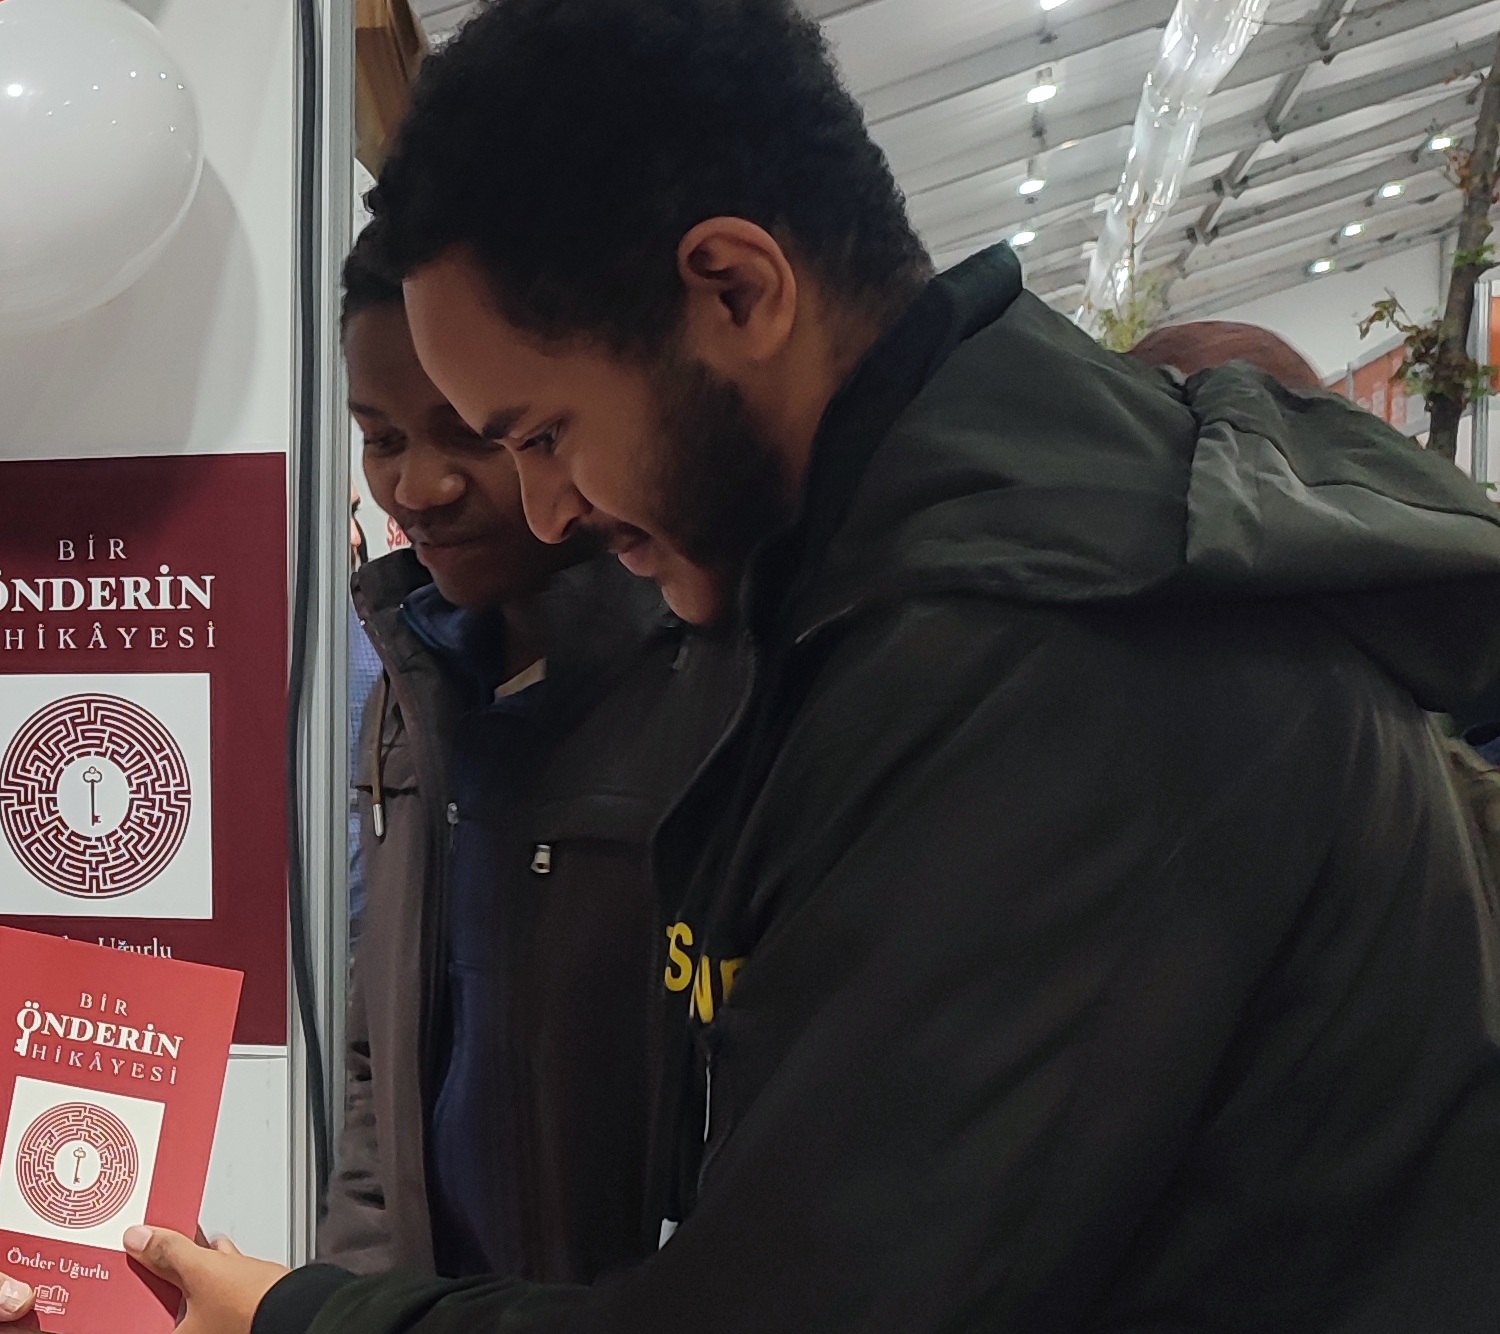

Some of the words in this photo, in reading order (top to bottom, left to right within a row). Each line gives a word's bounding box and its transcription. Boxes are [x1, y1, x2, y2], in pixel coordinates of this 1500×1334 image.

[58, 533, 128, 561] BİR
[4, 621, 216, 649] HİKÂYESİ
[80, 992, 128, 1016] BİR
[14, 1001, 184, 1059] ÖNDERİN
[32, 1043, 178, 1085] HİKÂYESİ
[7, 1247, 55, 1271] Önder
[59, 1258, 110, 1280] Uğurlu
